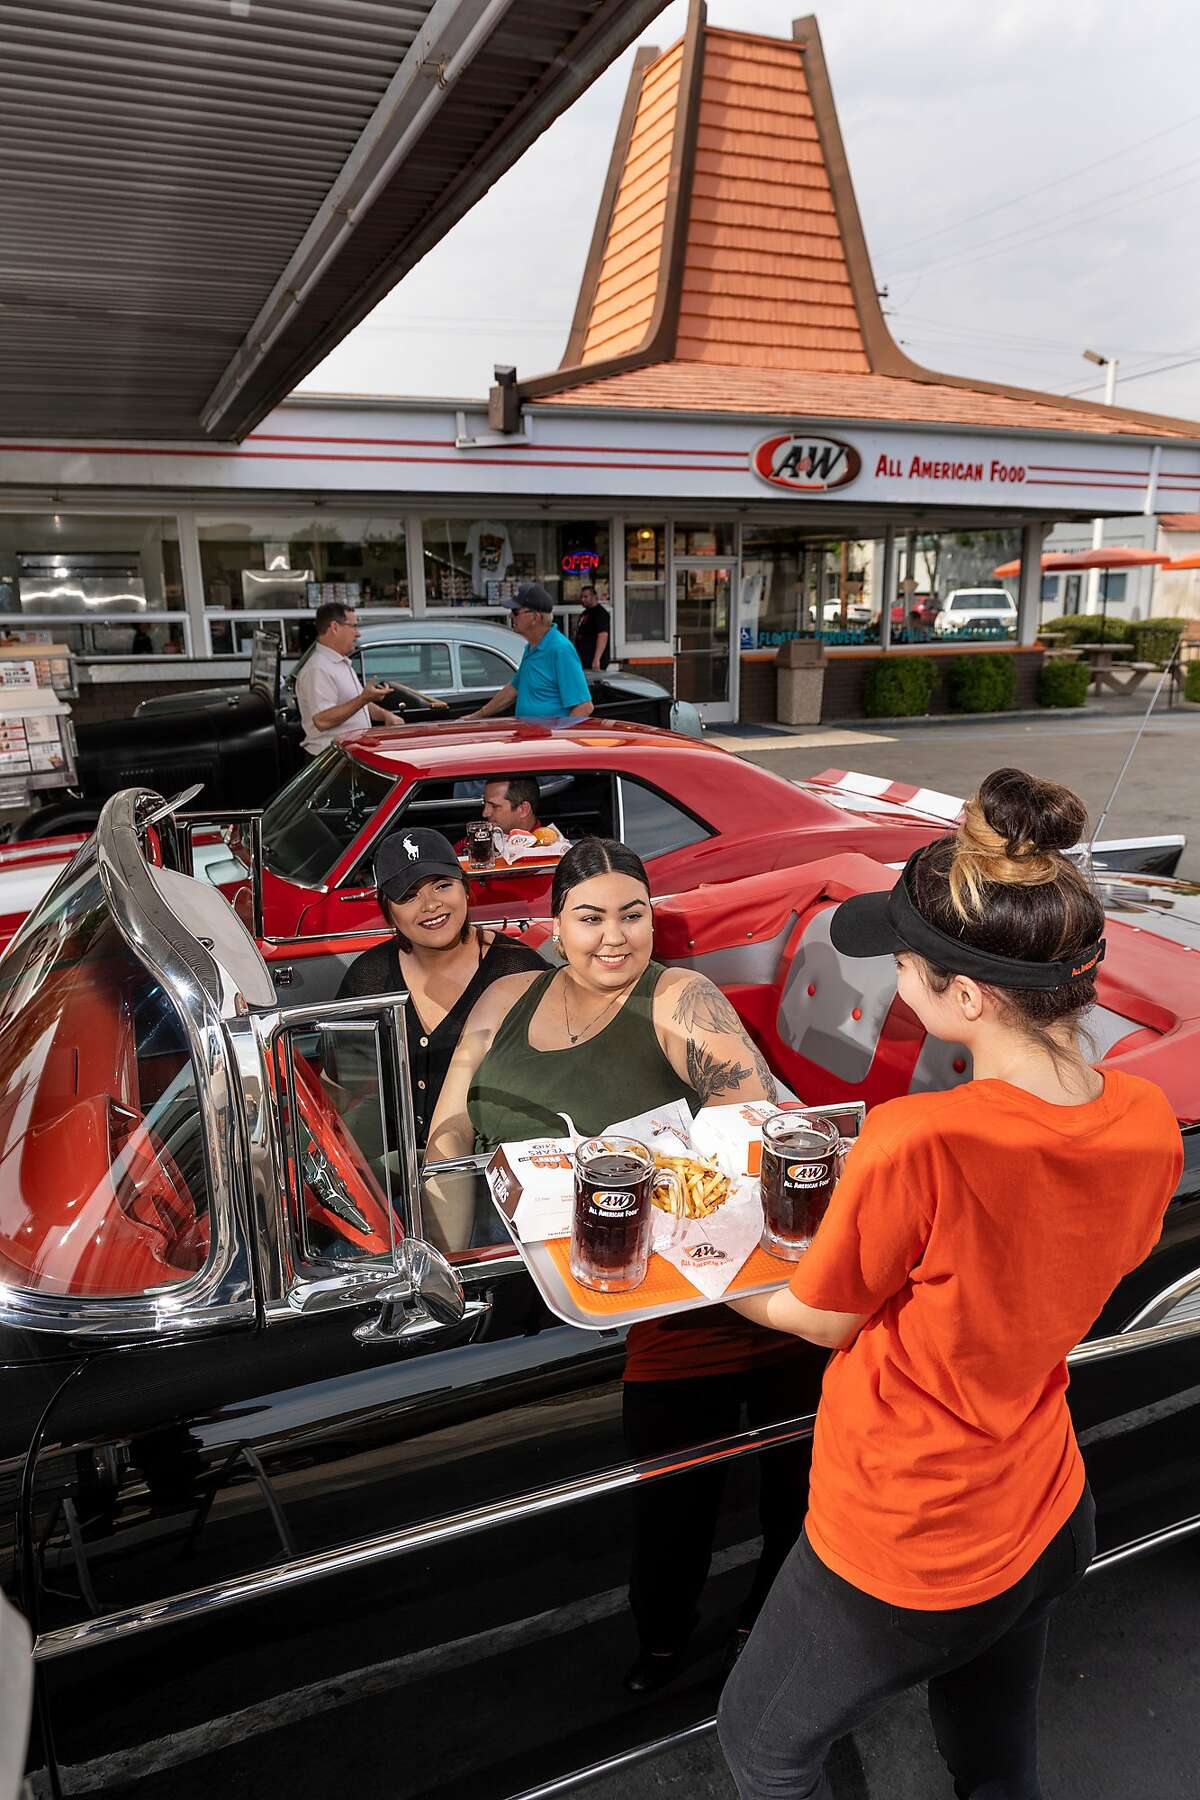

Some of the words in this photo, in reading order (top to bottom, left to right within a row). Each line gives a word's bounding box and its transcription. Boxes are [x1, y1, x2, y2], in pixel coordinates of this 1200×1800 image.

[875, 453, 902, 478] ALL
[908, 455, 983, 482] AMERICAN
[989, 460, 1026, 483] FOOD
[562, 555, 600, 571] OPEN
[493, 1177, 510, 1204] YEARS
[783, 1180, 793, 1188] ALL
[588, 1206, 598, 1216] ALL
[598, 1209, 625, 1218] AMERICAN
